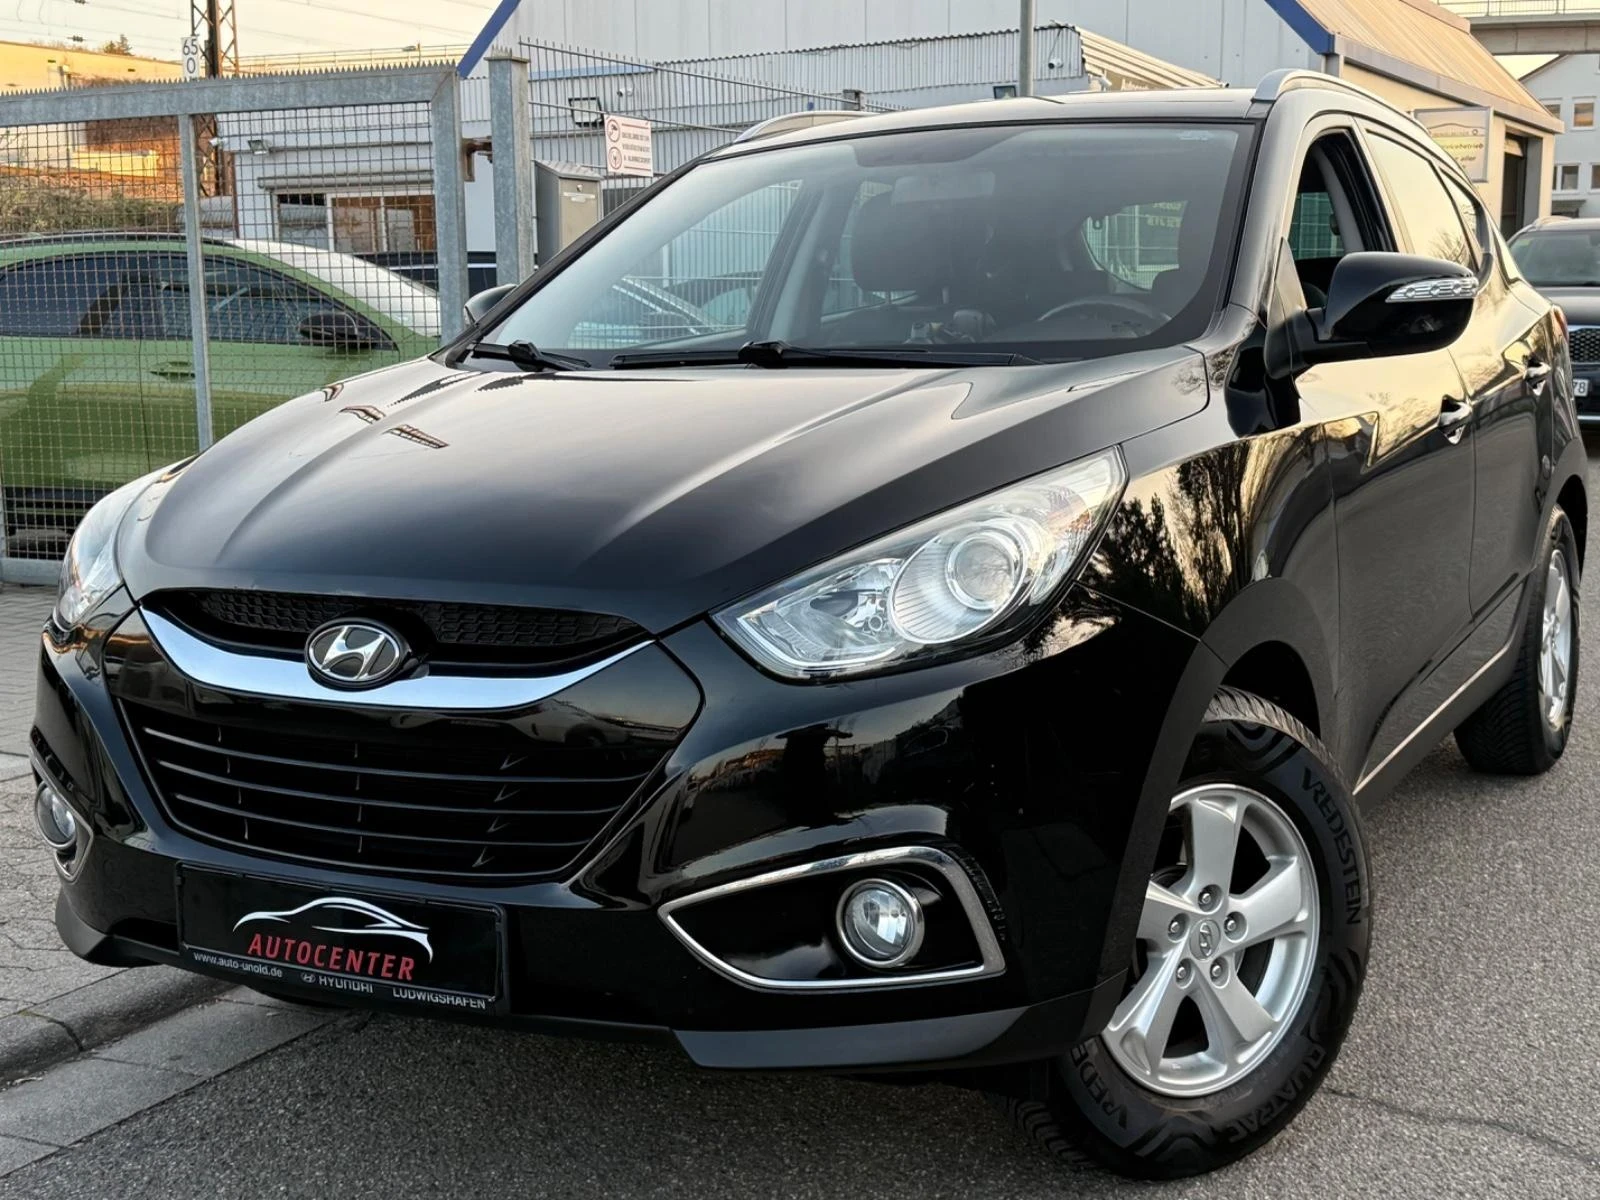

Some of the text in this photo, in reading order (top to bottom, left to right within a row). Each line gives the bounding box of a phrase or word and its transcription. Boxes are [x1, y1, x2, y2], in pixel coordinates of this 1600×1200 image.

[183, 38, 198, 56] 65
[186, 57, 196, 74] 0
[1302, 767, 1361, 925] VREDESTEIN
[193, 951, 283, 978] www.auto-unold.de
[247, 933, 415, 980] AUTOCENTER
[318, 975, 486, 1010] HYUNDAI LUDWIGSHAFEN
